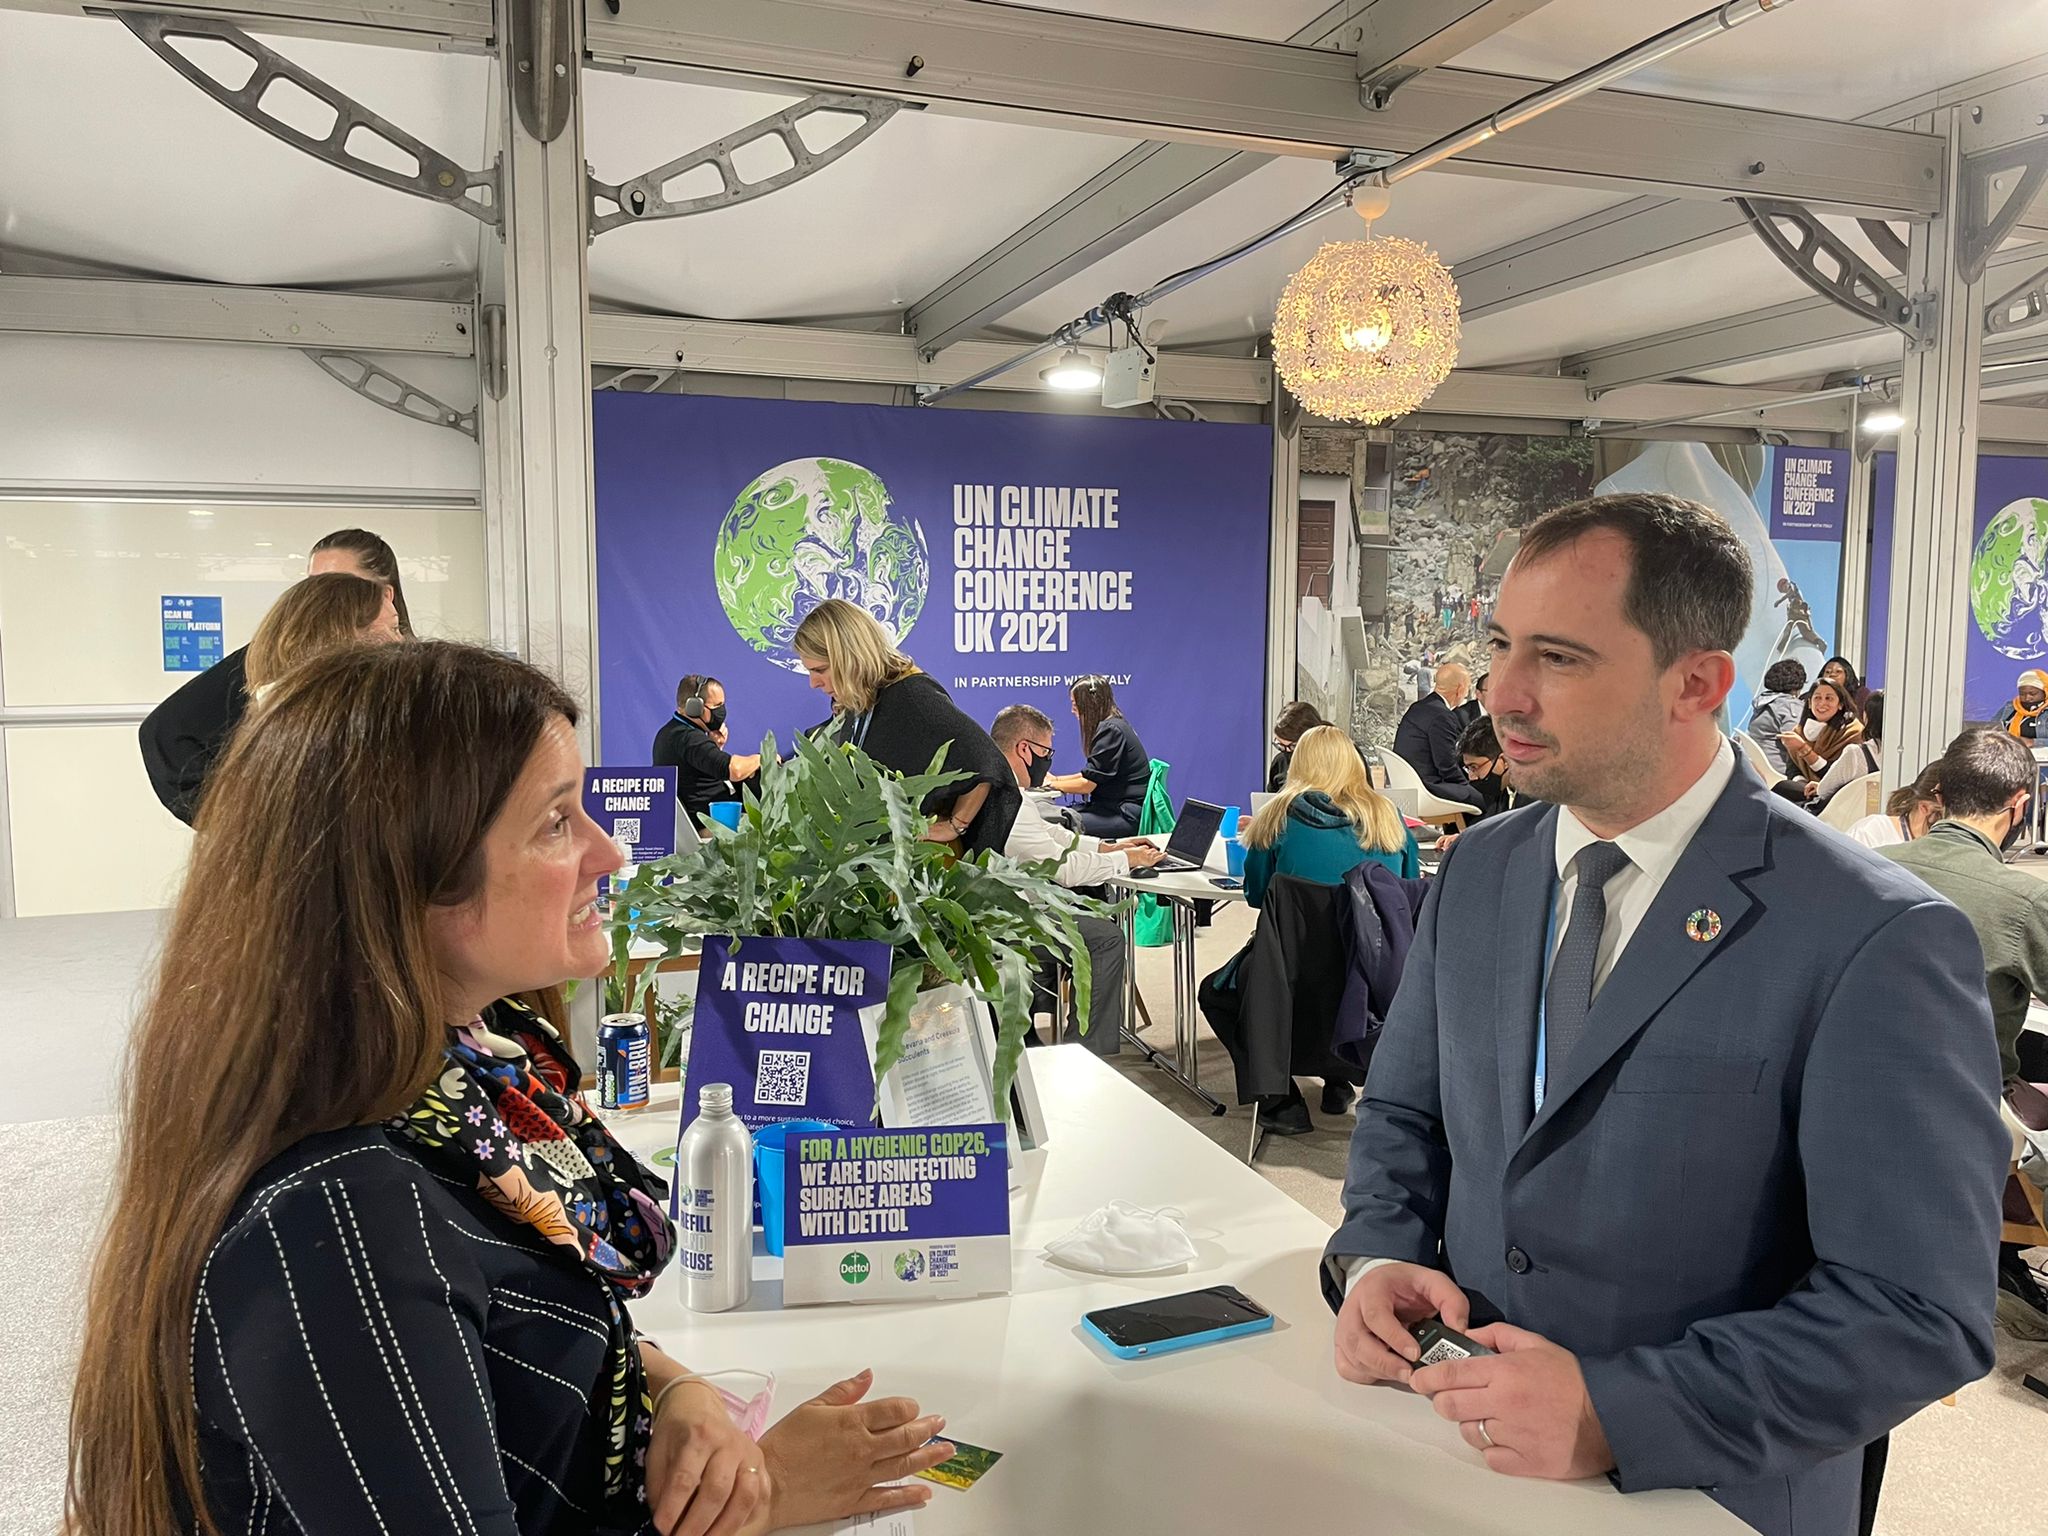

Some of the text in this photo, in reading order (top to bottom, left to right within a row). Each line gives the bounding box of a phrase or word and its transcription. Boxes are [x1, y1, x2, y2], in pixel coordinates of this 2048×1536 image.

[1785, 458, 1832, 474] UN CLIMATE
[1784, 473, 1817, 487] CHANGE
[954, 484, 1119, 528] UN CLIMATE
[1783, 487, 1834, 503] CONFERENCE
[1783, 501, 1815, 516] UK 2021
[954, 528, 1070, 569] CHANGE
[954, 570, 1132, 611] CONFERENCE
[954, 612, 1068, 653] UK 2021
[955, 674, 1132, 688] IN PARTNERSHIP WI TALY
[591, 778, 665, 793] A RECIPE FOR
[605, 796, 651, 811] CHANGE
[721, 962, 865, 996] A RECIPE FOR
[744, 1002, 834, 1035] CHANGE
[800, 1132, 990, 1162] FOR A HYGIENIC COP26,
[800, 1156, 976, 1186] WE ARE DISINFECTING
[800, 1183, 932, 1212] SURFACE AREAS
[681, 1210, 712, 1233] REFILL
[800, 1208, 909, 1237] WITH DETTOL
[681, 1248, 713, 1271] REUSE
[840, 1262, 869, 1274] Dettol
